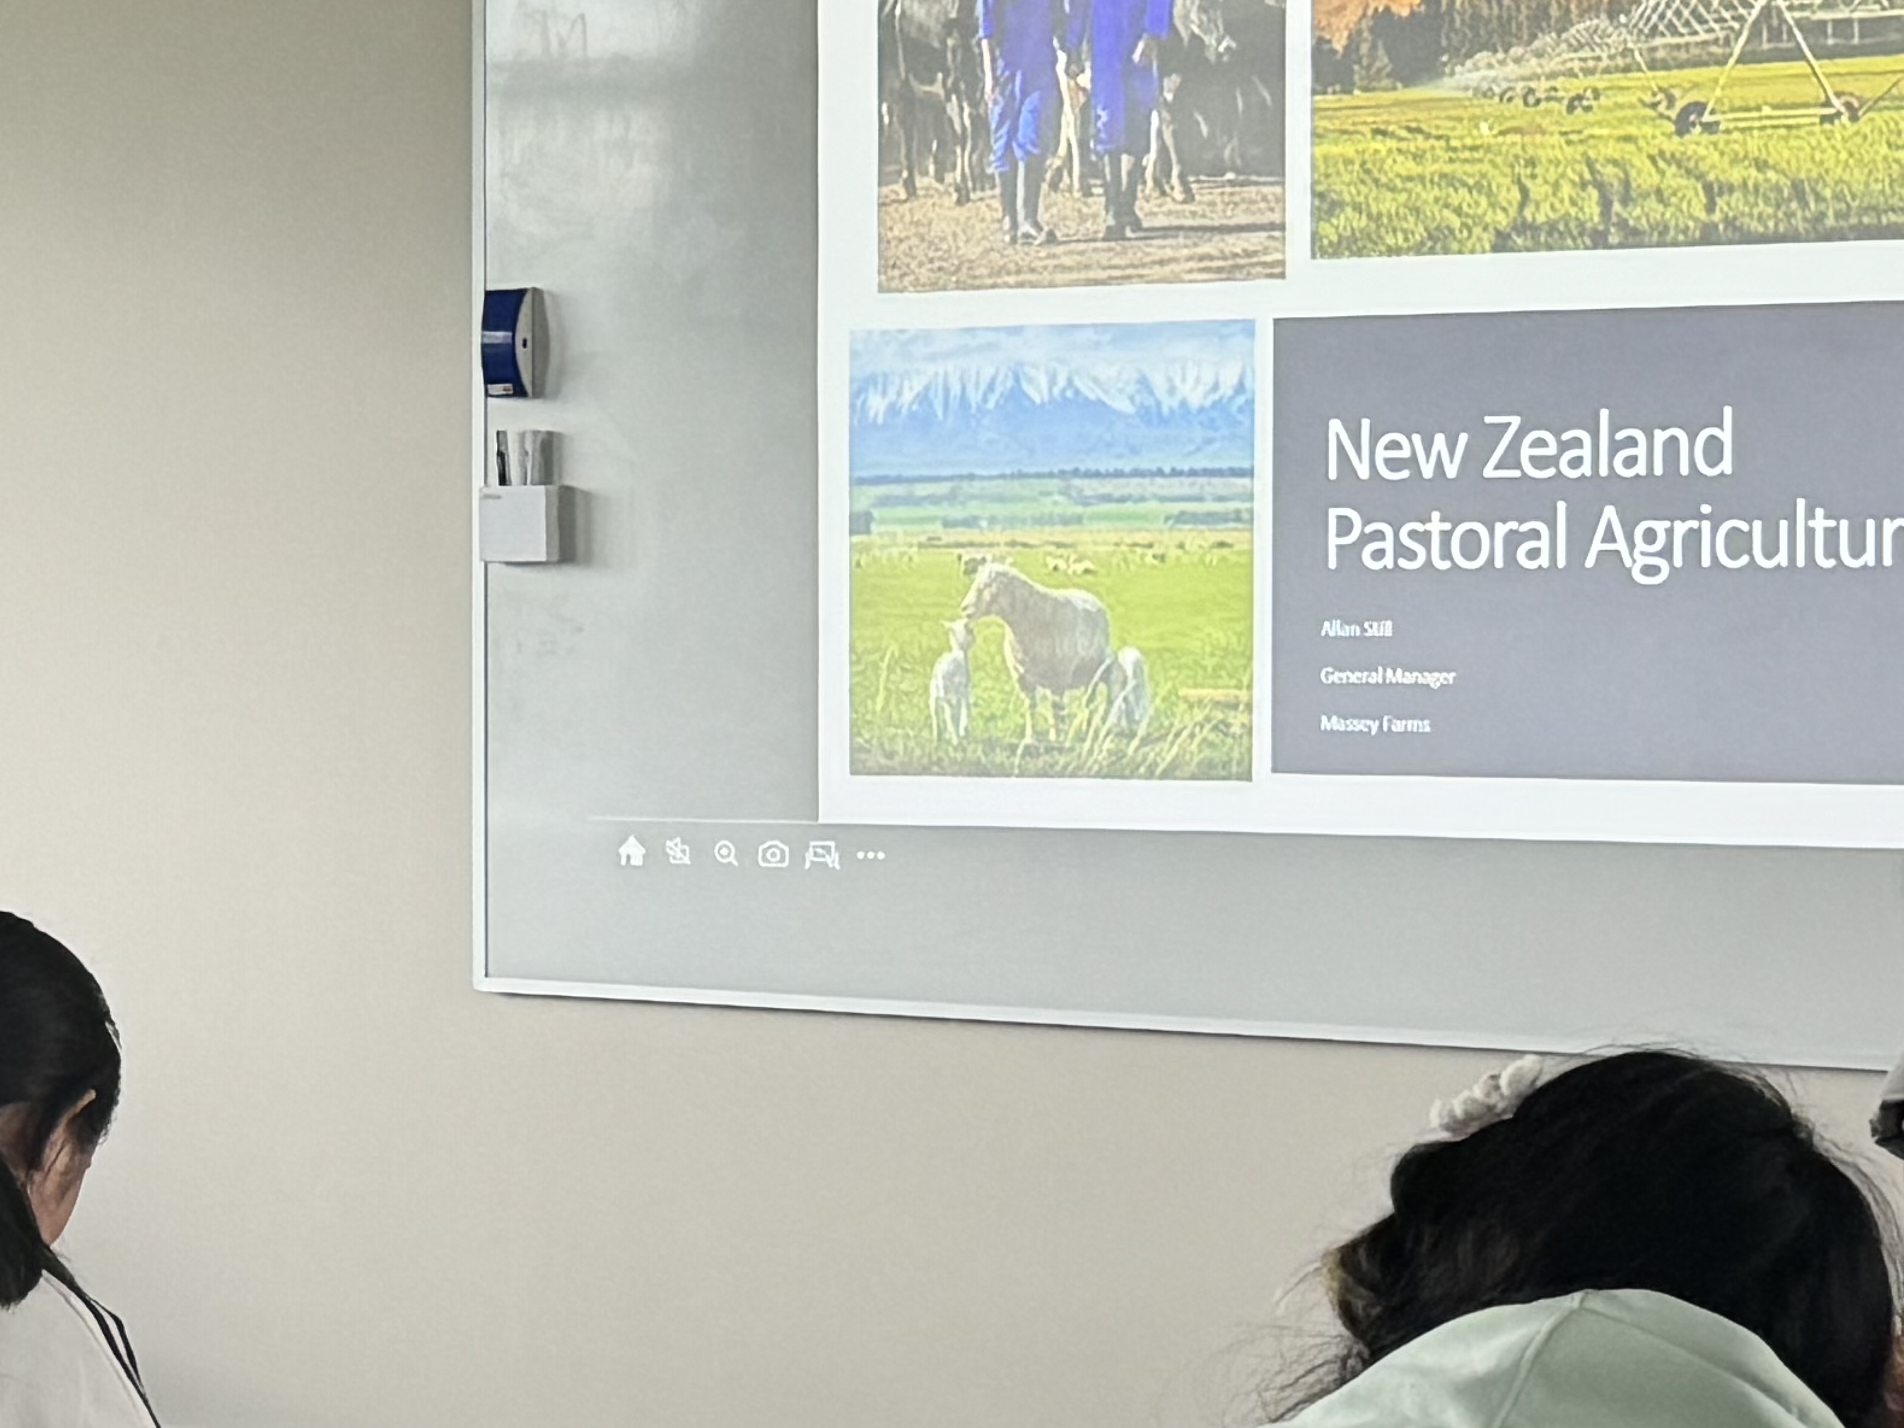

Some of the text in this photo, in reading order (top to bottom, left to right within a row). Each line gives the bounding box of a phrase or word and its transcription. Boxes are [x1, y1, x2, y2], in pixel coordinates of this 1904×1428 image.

[1328, 405, 1733, 481] New Zealand
[1327, 497, 1904, 585] Pastoral Agricultur
[1320, 619, 1361, 638] Allan
[1320, 665, 1457, 690] General Manager
[1320, 714, 1431, 736] Massey Farms
